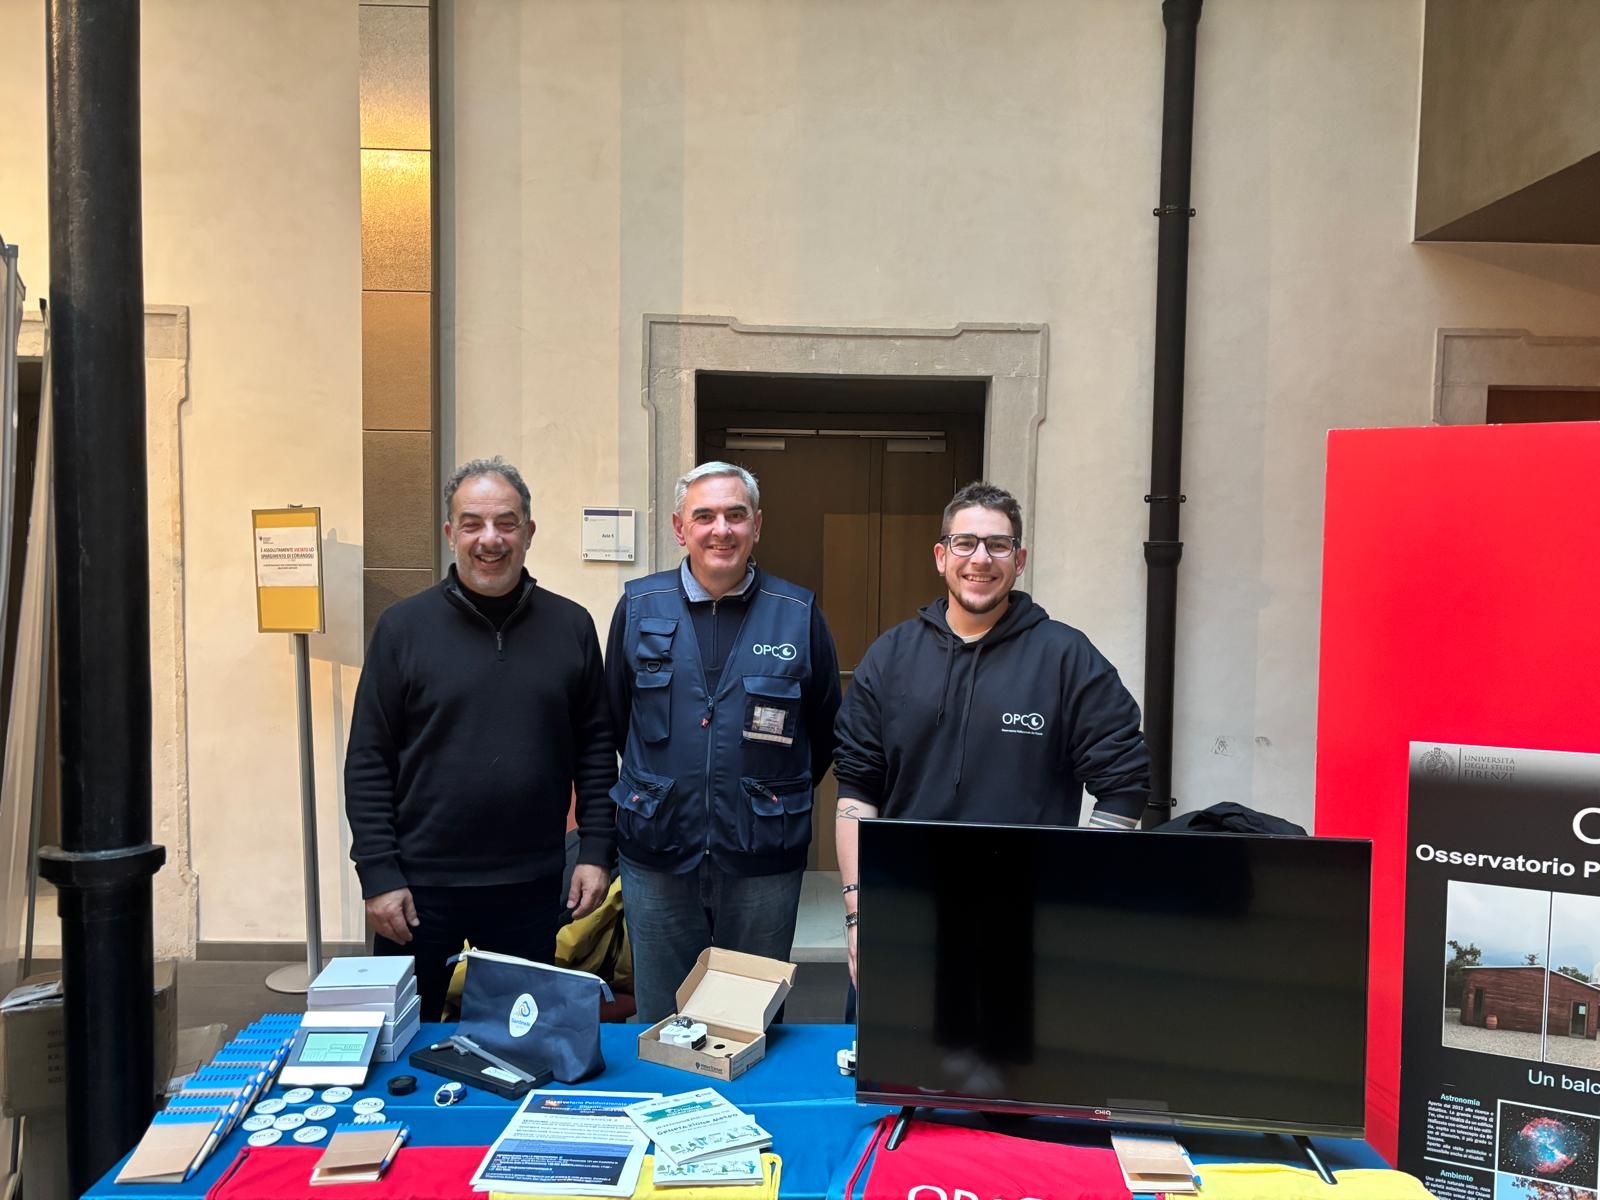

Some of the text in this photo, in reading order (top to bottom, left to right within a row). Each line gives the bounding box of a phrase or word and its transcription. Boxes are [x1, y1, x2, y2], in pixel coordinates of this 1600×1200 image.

[1416, 844, 1575, 877] Osservatorio
[1528, 1069, 1555, 1088] Un
[1440, 1093, 1480, 1106] Astronomia
[1440, 1170, 1473, 1182] Ambiente
